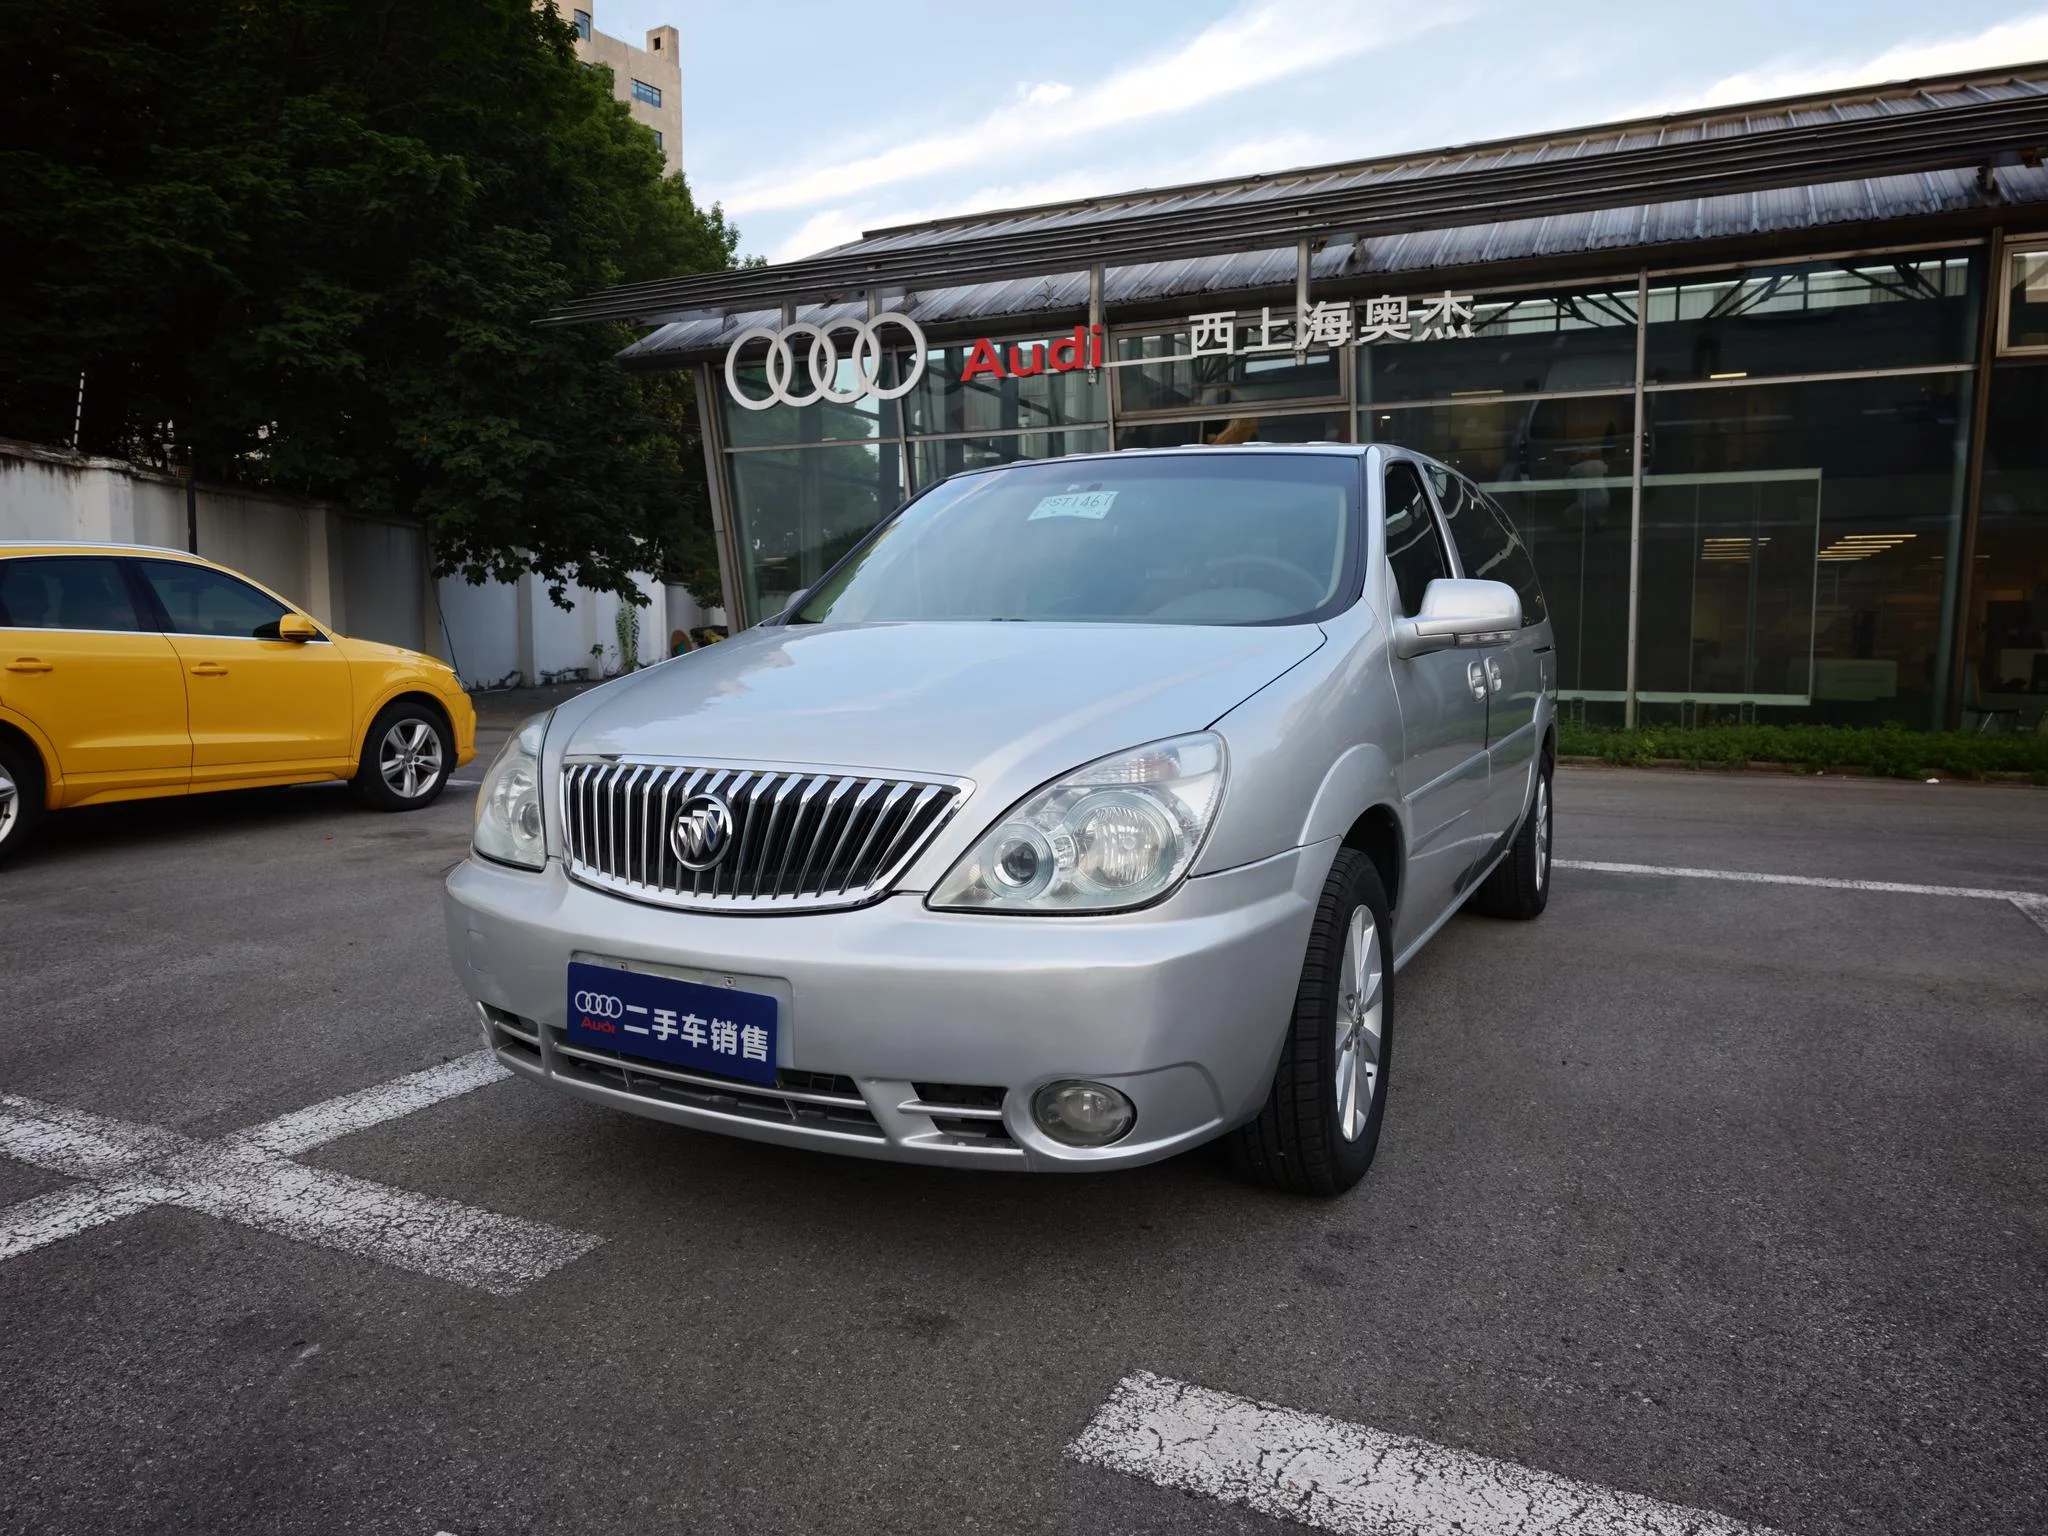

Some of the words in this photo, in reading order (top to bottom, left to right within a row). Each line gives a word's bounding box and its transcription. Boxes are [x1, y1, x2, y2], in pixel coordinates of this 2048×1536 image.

[960, 324, 1102, 382] Audi
[1188, 290, 1475, 358] 西上海奥杰
[580, 1015, 616, 1034] Audi
[623, 1004, 769, 1063] 二手车销售
